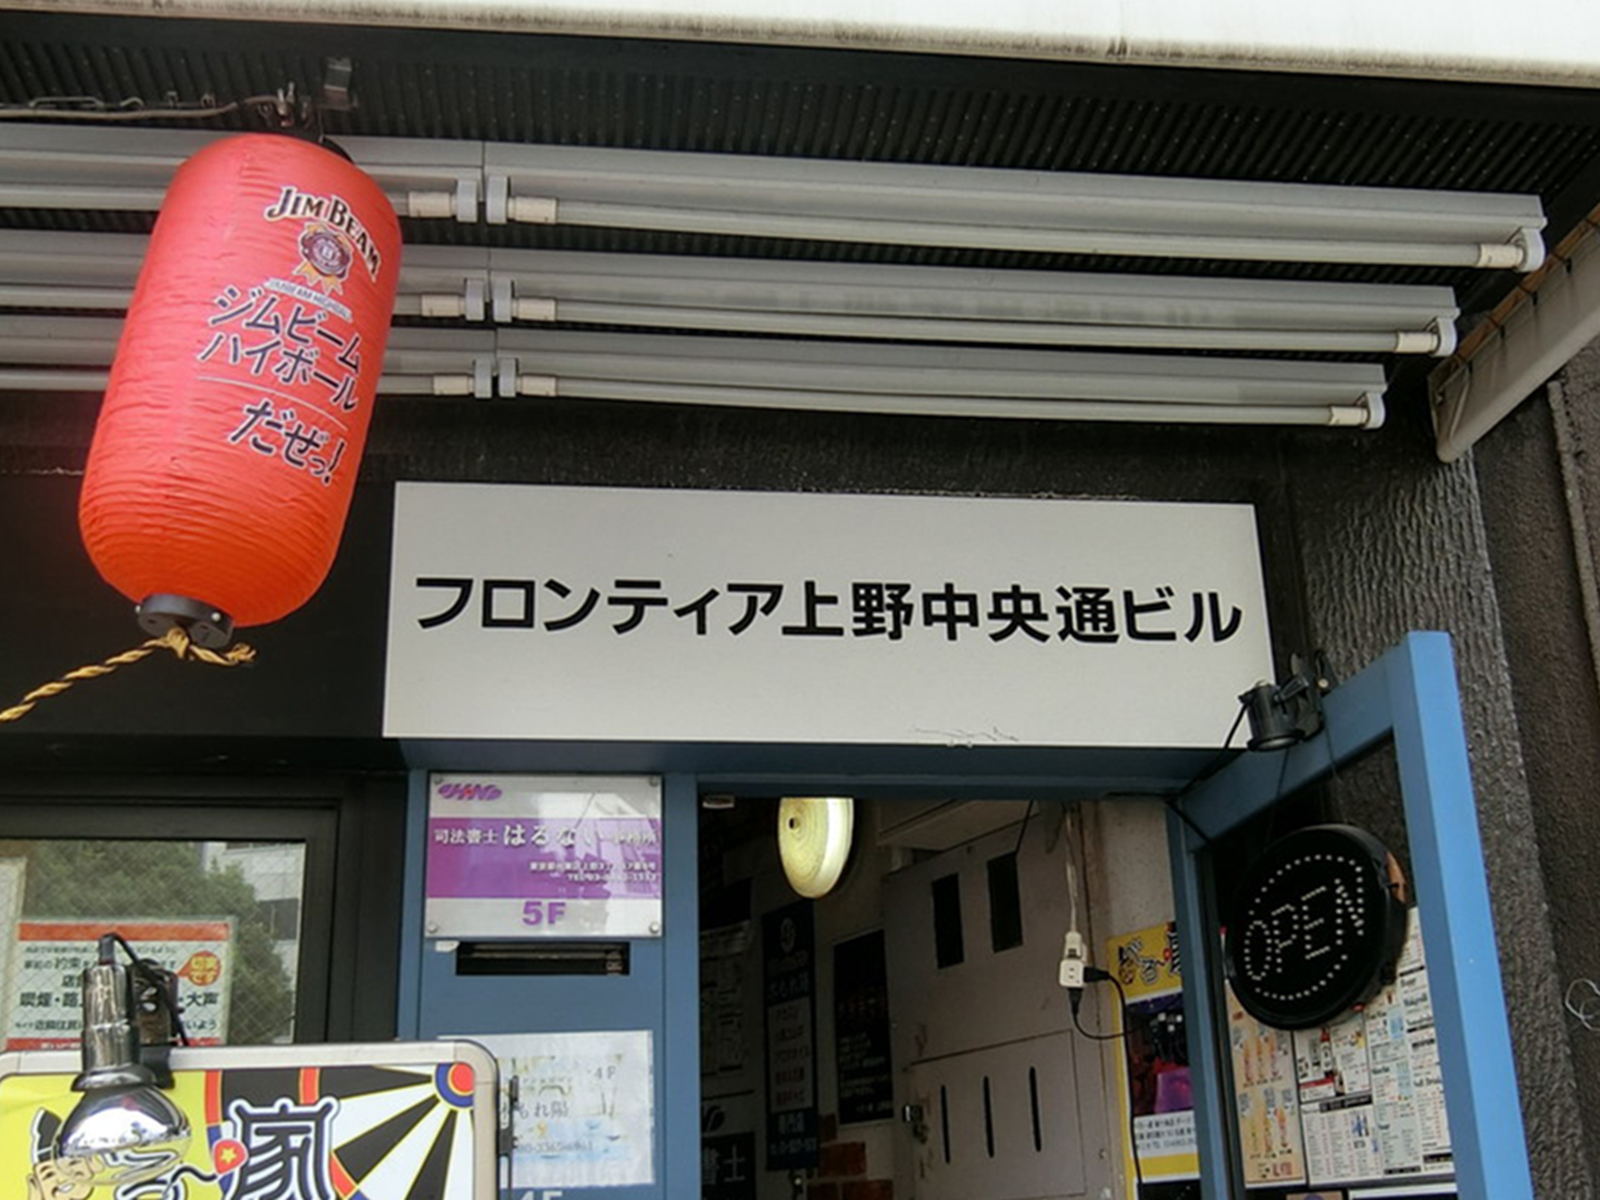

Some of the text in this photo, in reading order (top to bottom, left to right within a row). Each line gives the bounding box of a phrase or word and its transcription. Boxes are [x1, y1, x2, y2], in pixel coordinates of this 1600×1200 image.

[266, 187, 381, 280] JIM BEAM
[211, 286, 362, 374] ジムビーム
[199, 333, 359, 411] ハイボール
[415, 576, 1243, 644] フロンティア上野中央通ビル
[522, 900, 567, 926] 5F
[1244, 865, 1365, 980] OPEN
